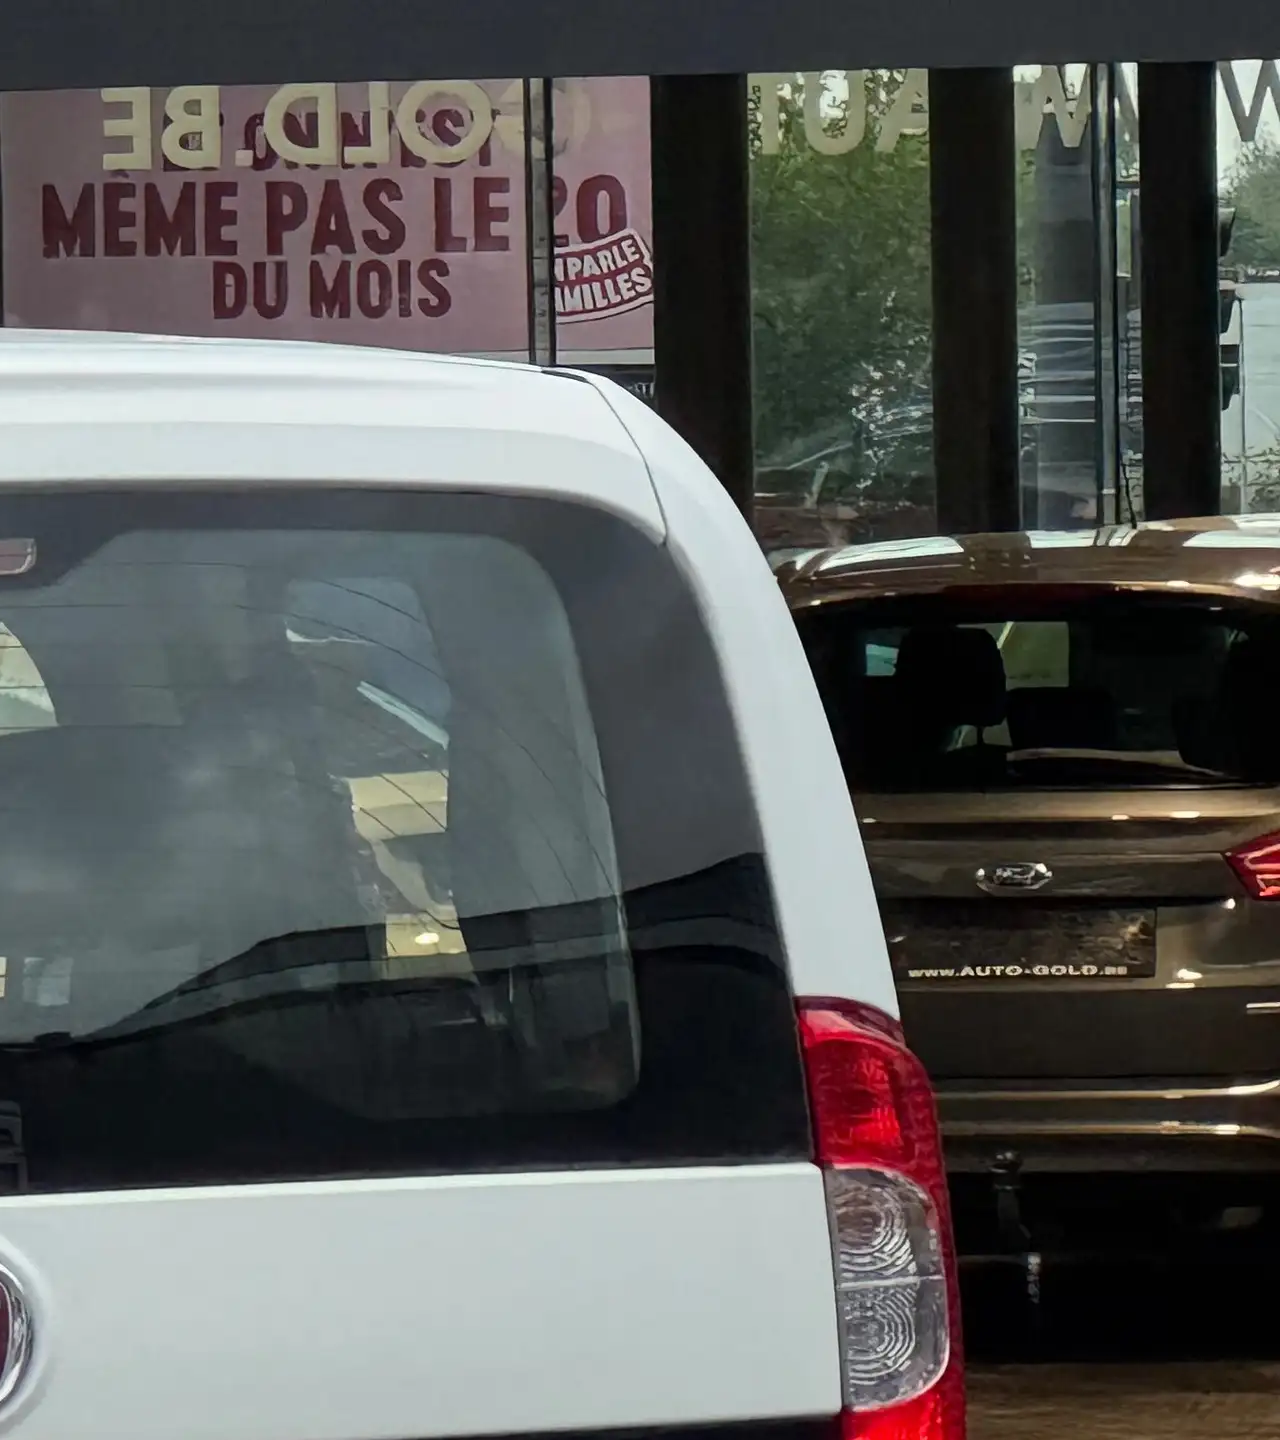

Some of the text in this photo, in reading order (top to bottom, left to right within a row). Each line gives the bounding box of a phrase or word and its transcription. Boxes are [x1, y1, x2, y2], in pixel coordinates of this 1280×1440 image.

[42, 170, 239, 258] MÊME
[265, 177, 407, 257] PAS
[434, 177, 510, 253] LE
[213, 258, 452, 319] DU MOIS
